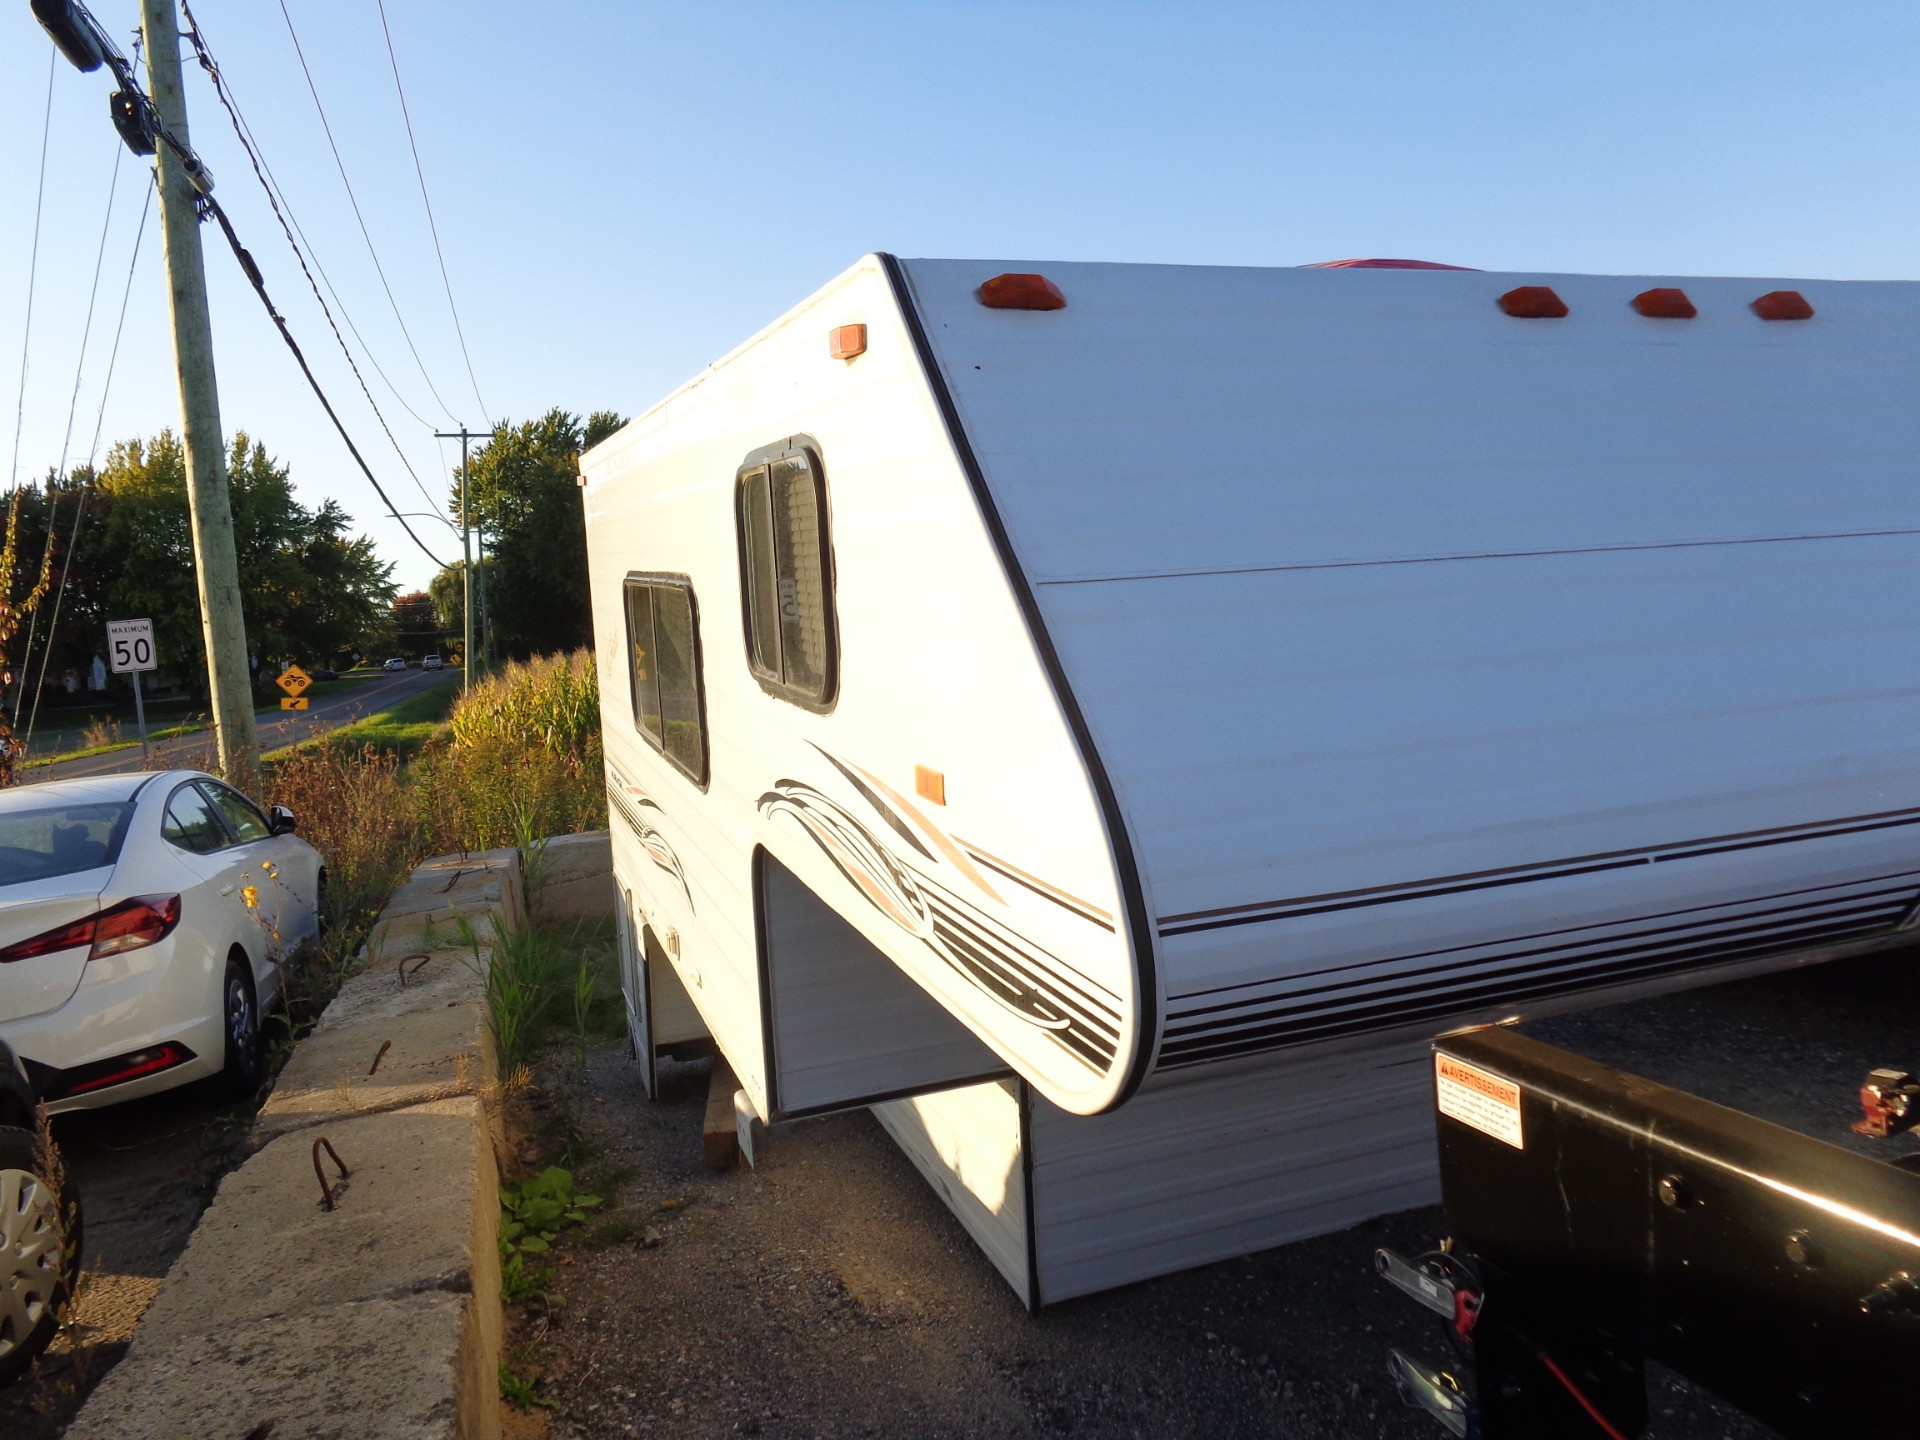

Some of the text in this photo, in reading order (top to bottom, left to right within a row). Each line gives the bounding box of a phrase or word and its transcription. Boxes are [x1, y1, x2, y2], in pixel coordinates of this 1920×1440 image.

[111, 625, 149, 634] MAXIMUM
[115, 638, 150, 666] 50
[1449, 1066, 1517, 1104] AVERTISSEMENT
